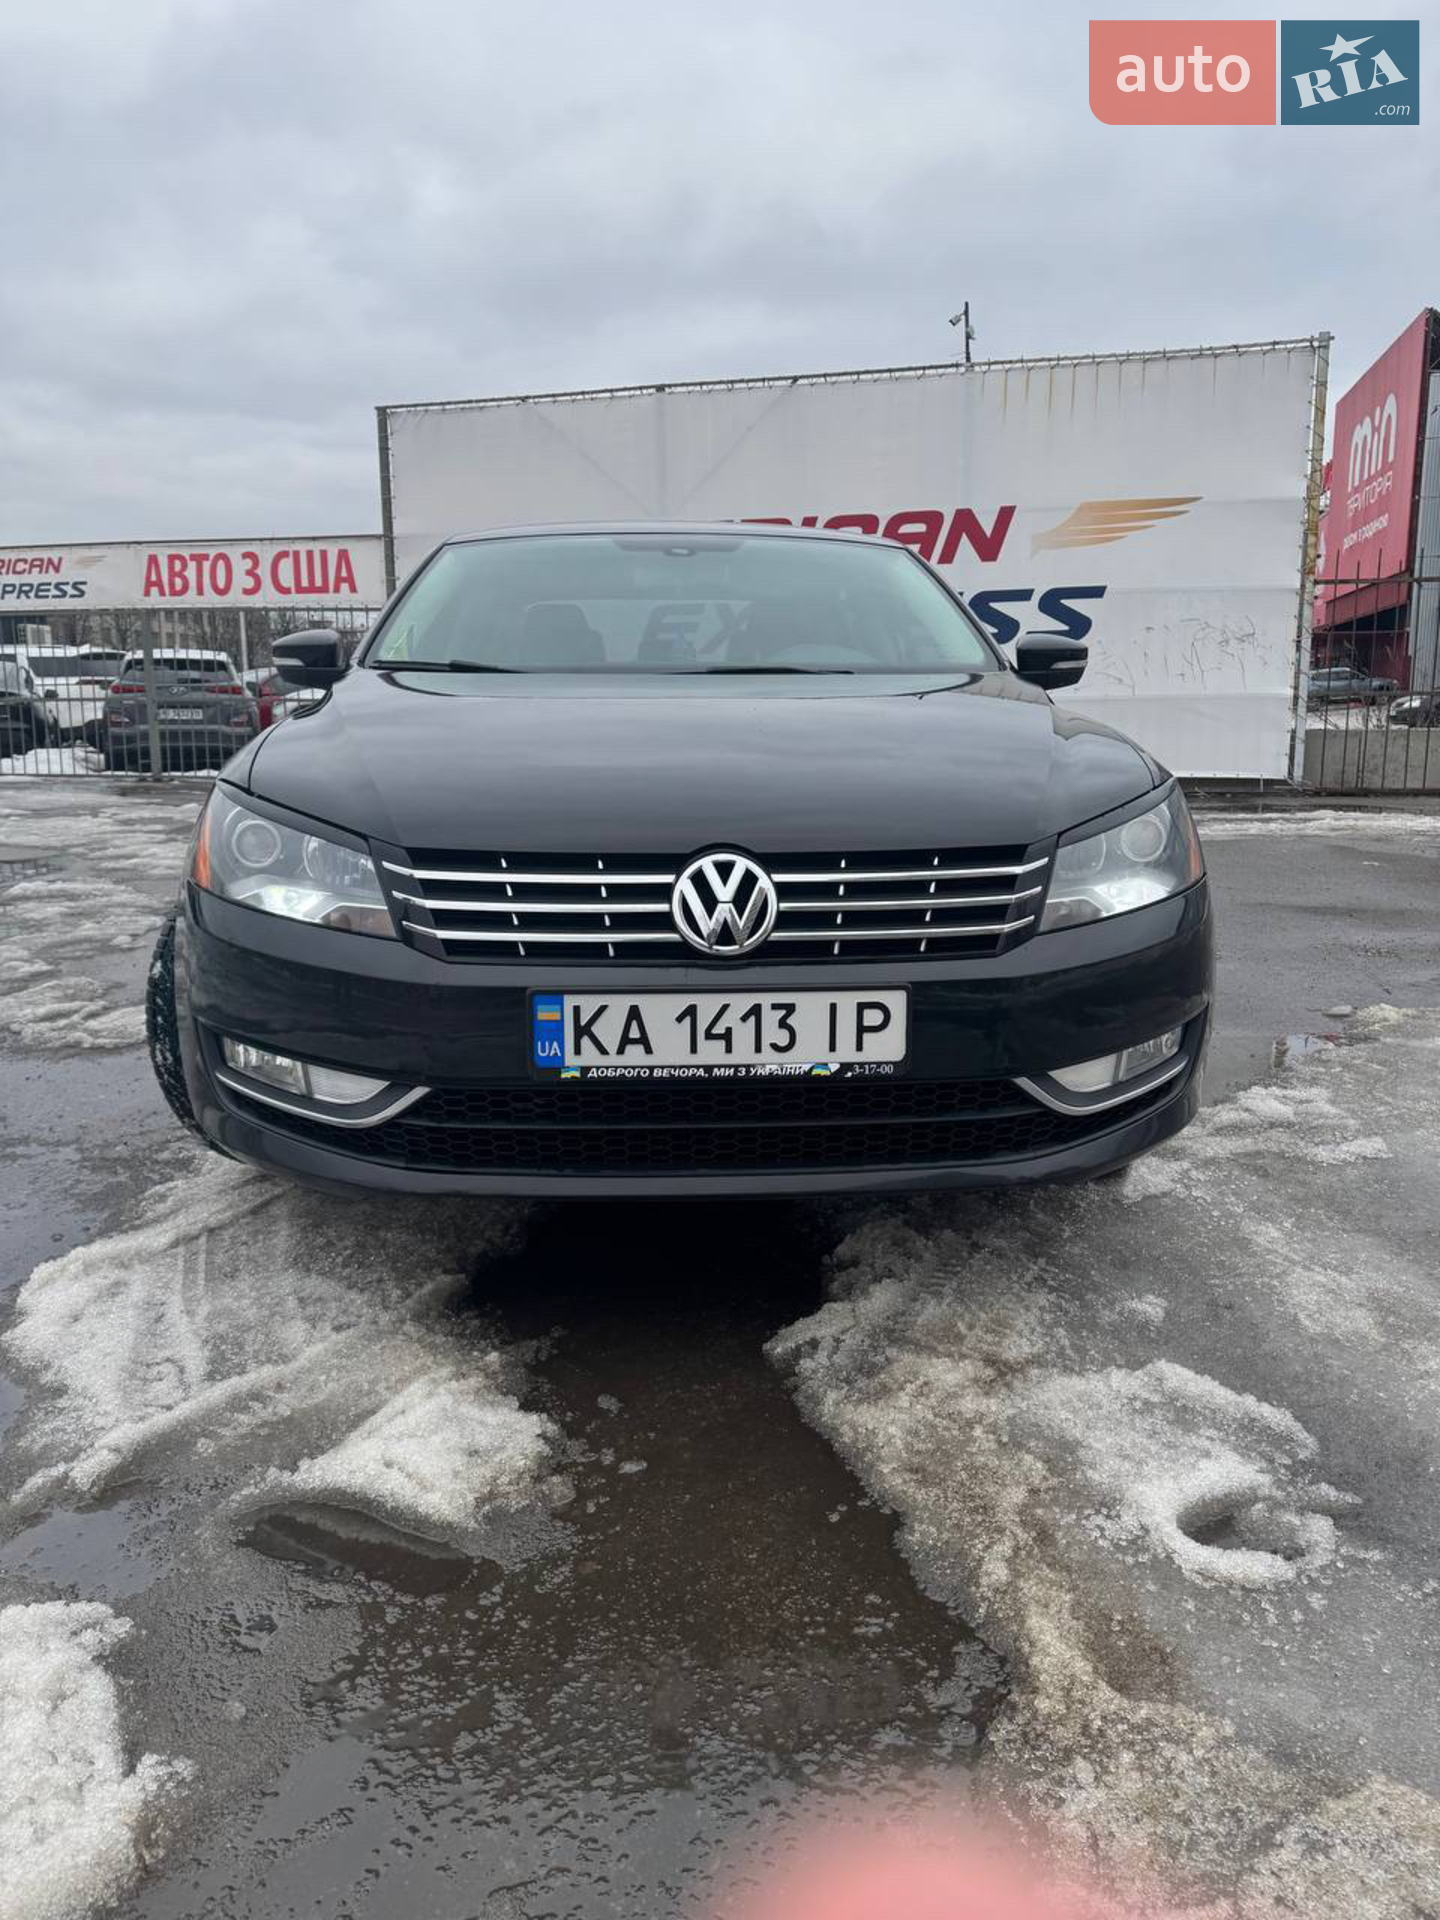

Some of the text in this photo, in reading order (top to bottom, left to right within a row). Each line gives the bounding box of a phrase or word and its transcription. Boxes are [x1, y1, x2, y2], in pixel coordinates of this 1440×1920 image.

[143, 552, 234, 598] АВТО
[270, 549, 358, 595] США
[571, 1001, 892, 1057] KA 1413 IP
[537, 1041, 562, 1057] UA
[587, 1067, 650, 1078] ДОБРОГО
[653, 1067, 709, 1078] ВЕЧОРА,
[712, 1066, 735, 1077] МИ
[737, 1066, 746, 1077] З
